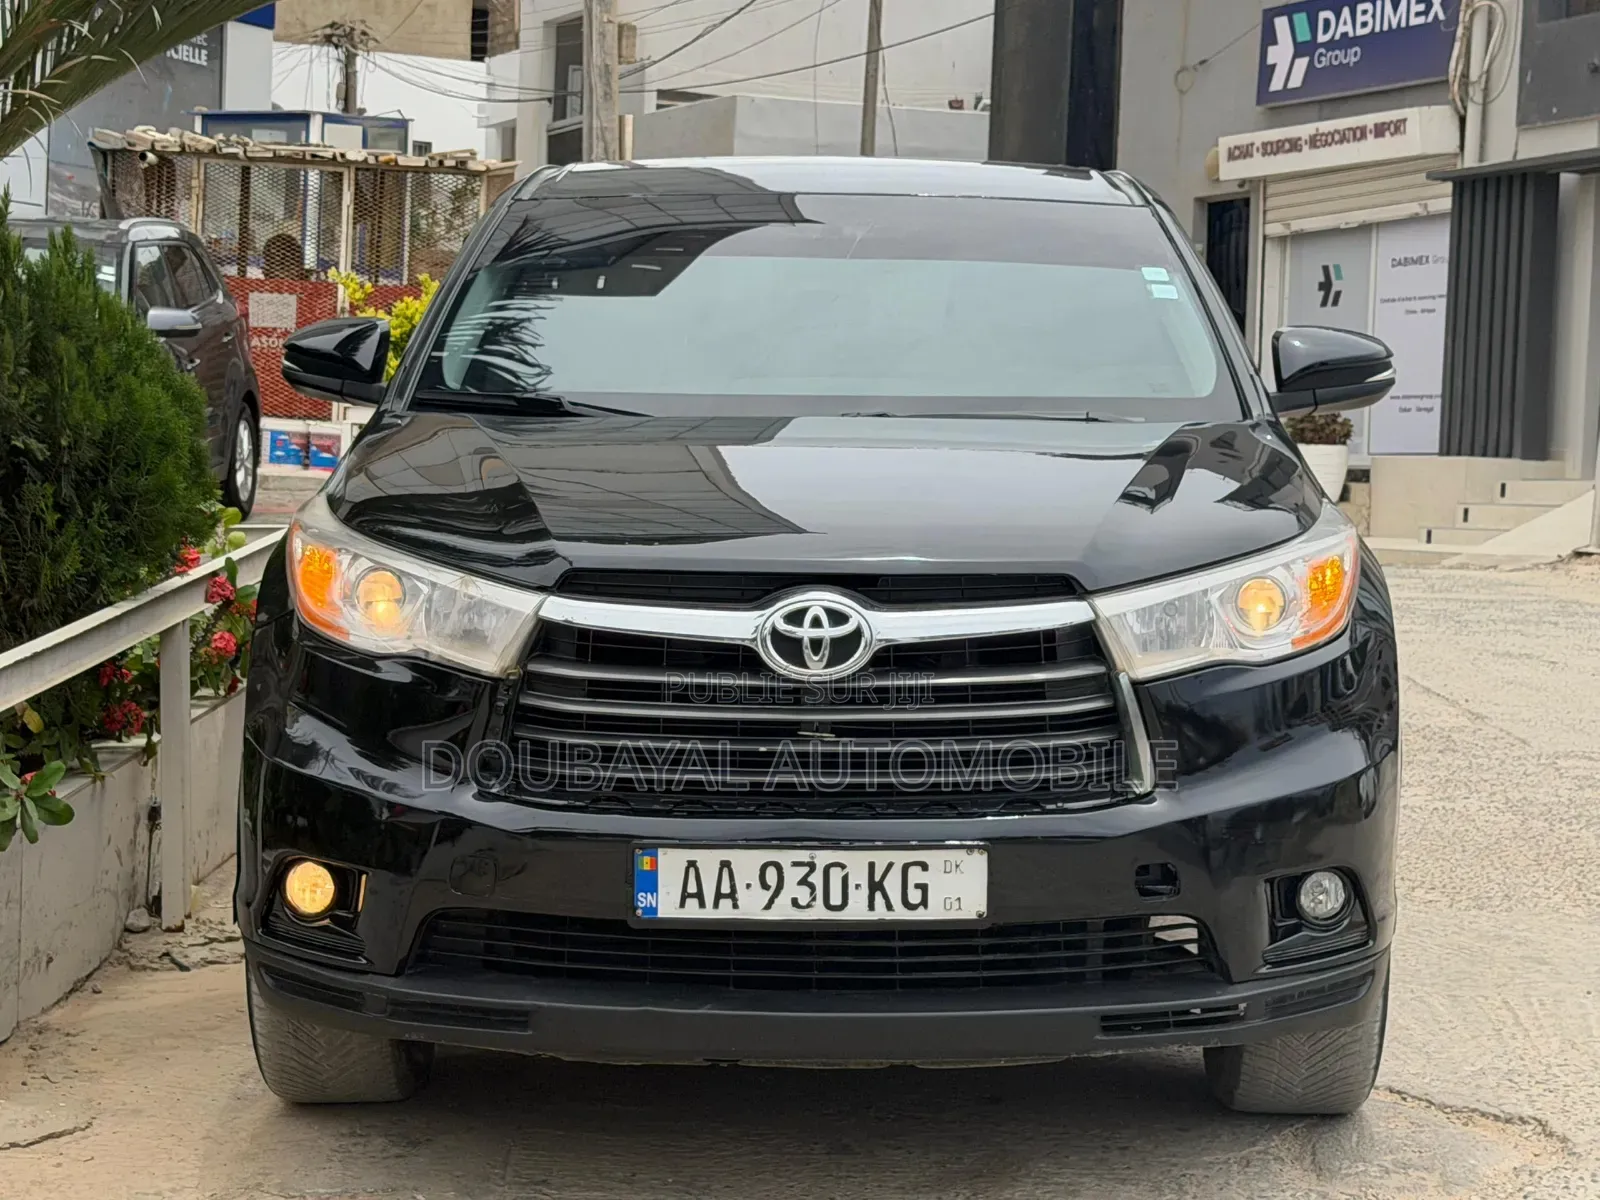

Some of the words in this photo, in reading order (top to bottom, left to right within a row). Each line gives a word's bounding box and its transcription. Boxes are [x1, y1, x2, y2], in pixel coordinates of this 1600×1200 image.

[1316, 0, 1446, 43] DABIMEX
[1313, 46, 1362, 68] Group
[1227, 142, 1255, 162] ACHAT
[1261, 136, 1303, 157] SOURCING
[1308, 126, 1368, 150] NÉGOCIATION
[1373, 118, 1408, 139] IMPORT
[1391, 255, 1430, 268] DABIMEX
[943, 859, 965, 874] DK
[636, 891, 657, 908] SN
